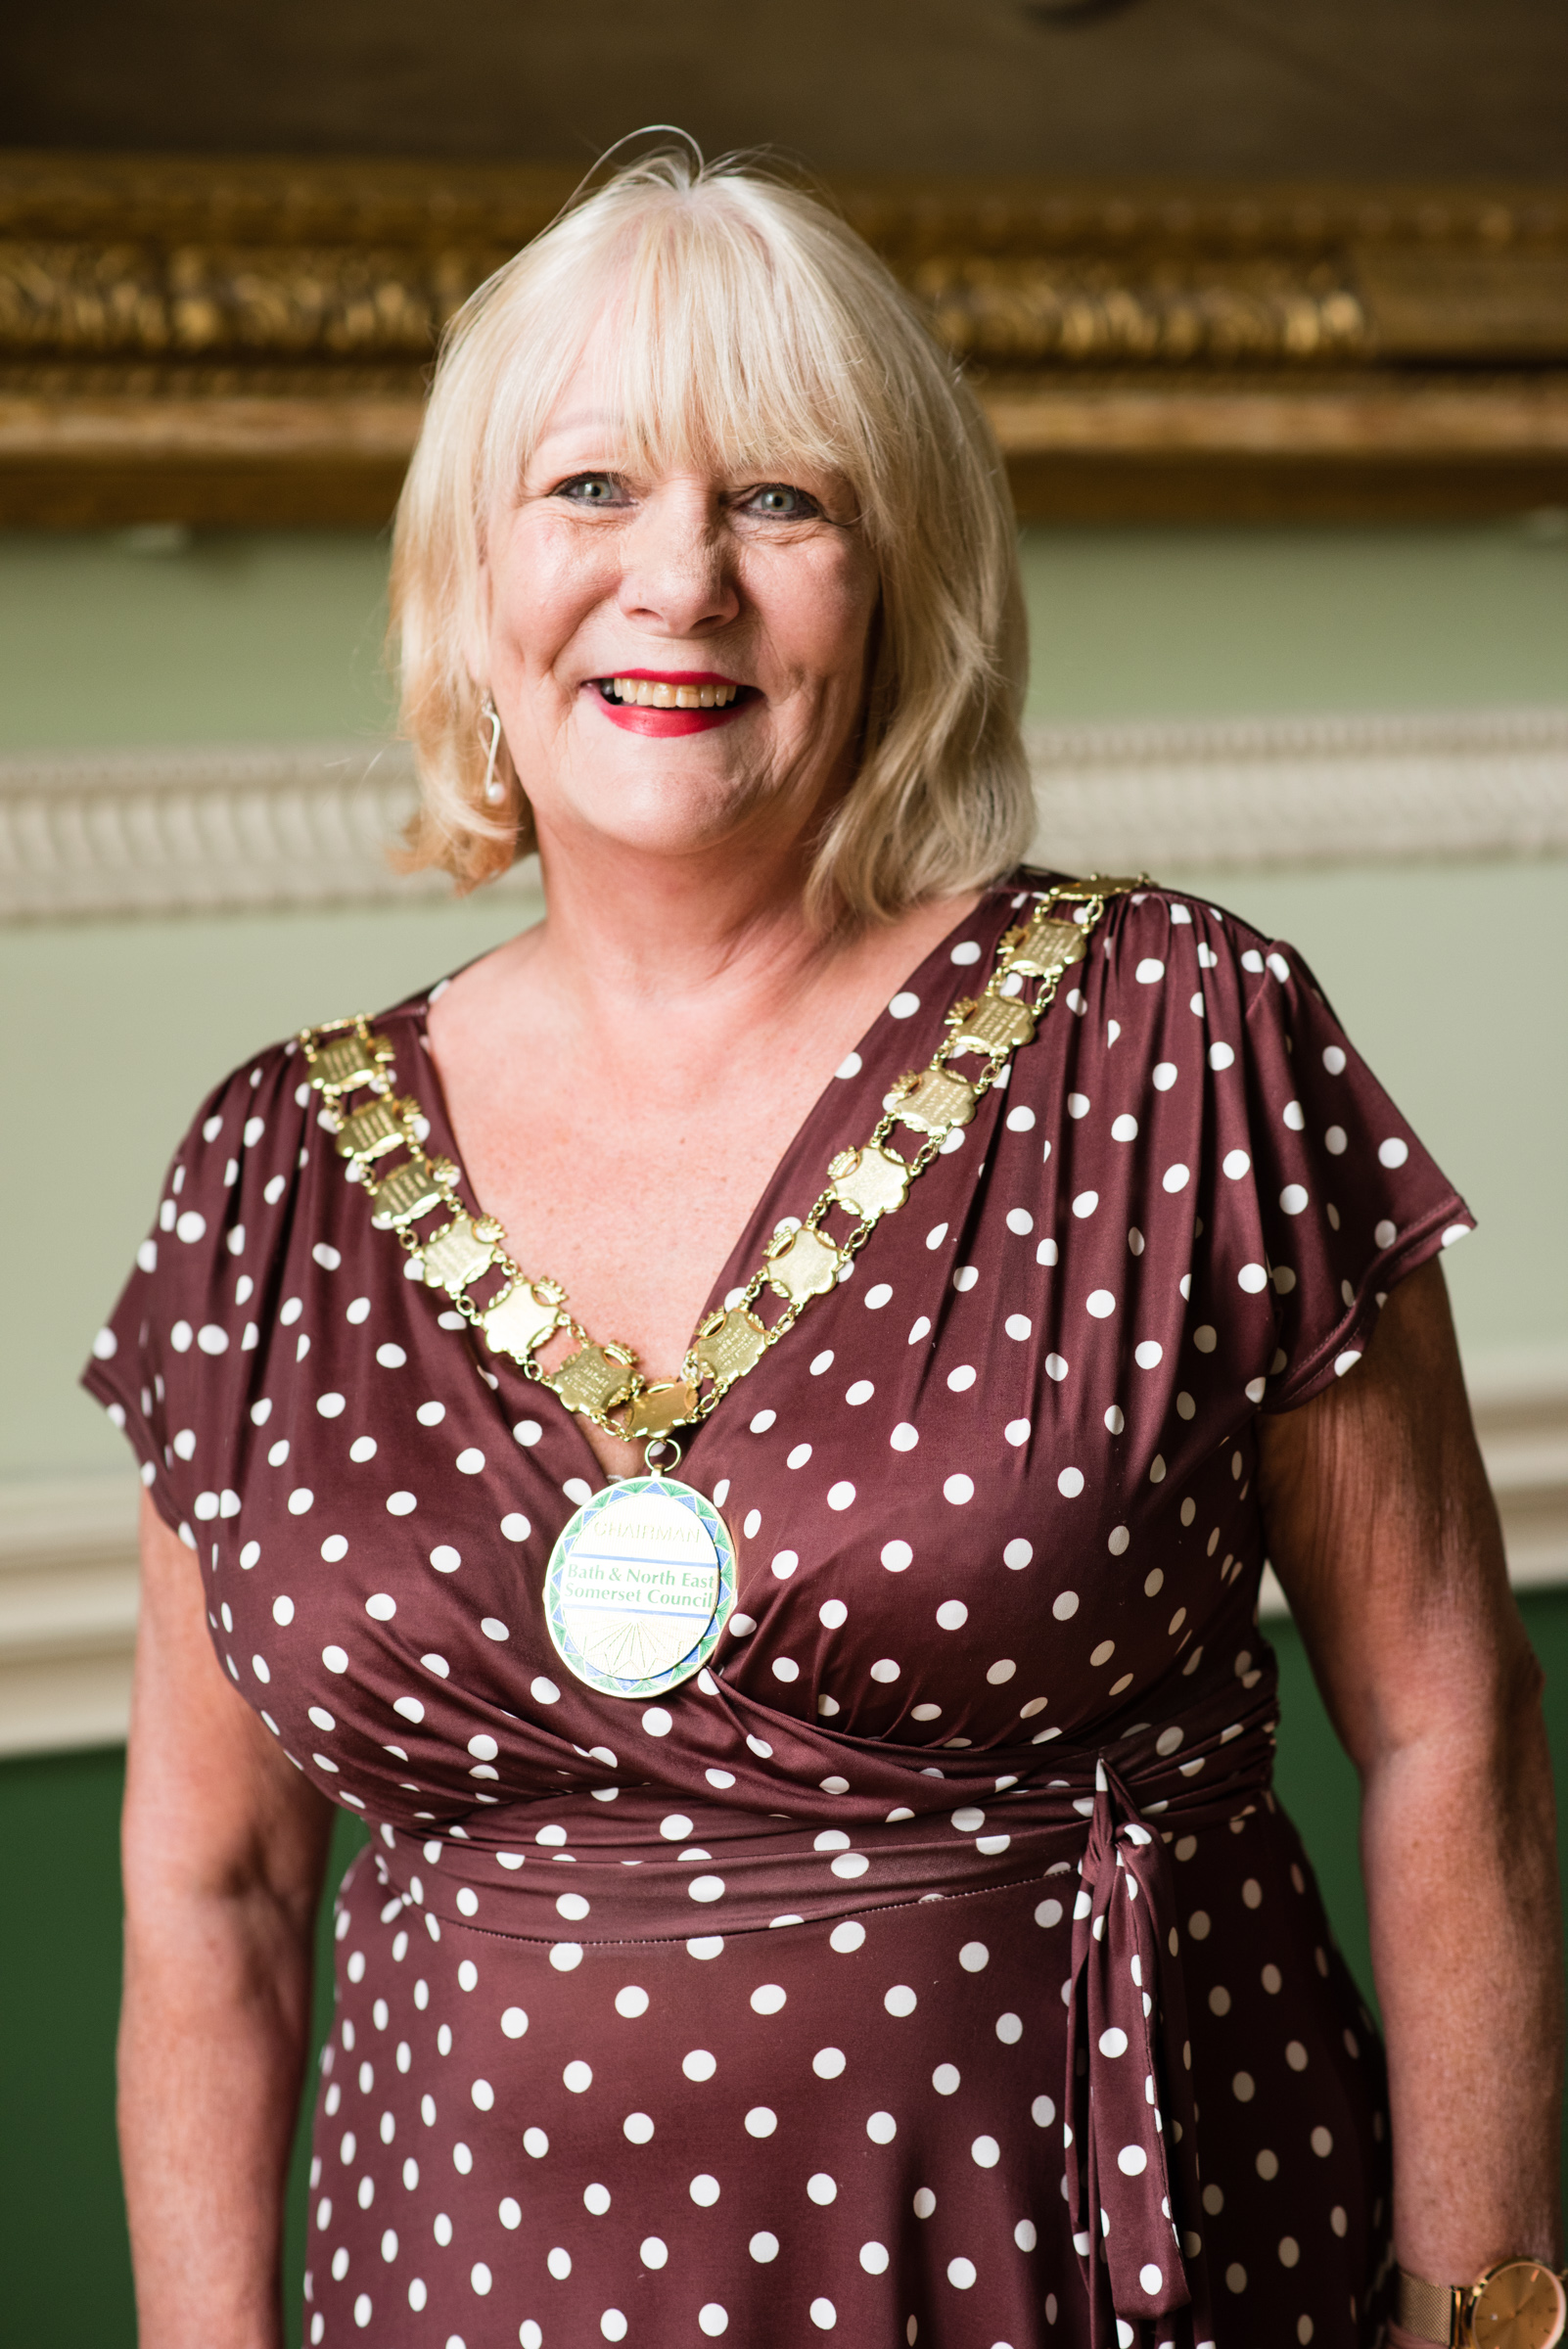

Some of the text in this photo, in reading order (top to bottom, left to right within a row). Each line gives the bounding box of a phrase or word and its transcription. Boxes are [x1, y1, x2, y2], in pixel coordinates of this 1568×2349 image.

[594, 1521, 700, 1543] CHAIRMAN
[568, 1564, 715, 1589] Bath & North East
[565, 1583, 714, 1608] Somerset Council
